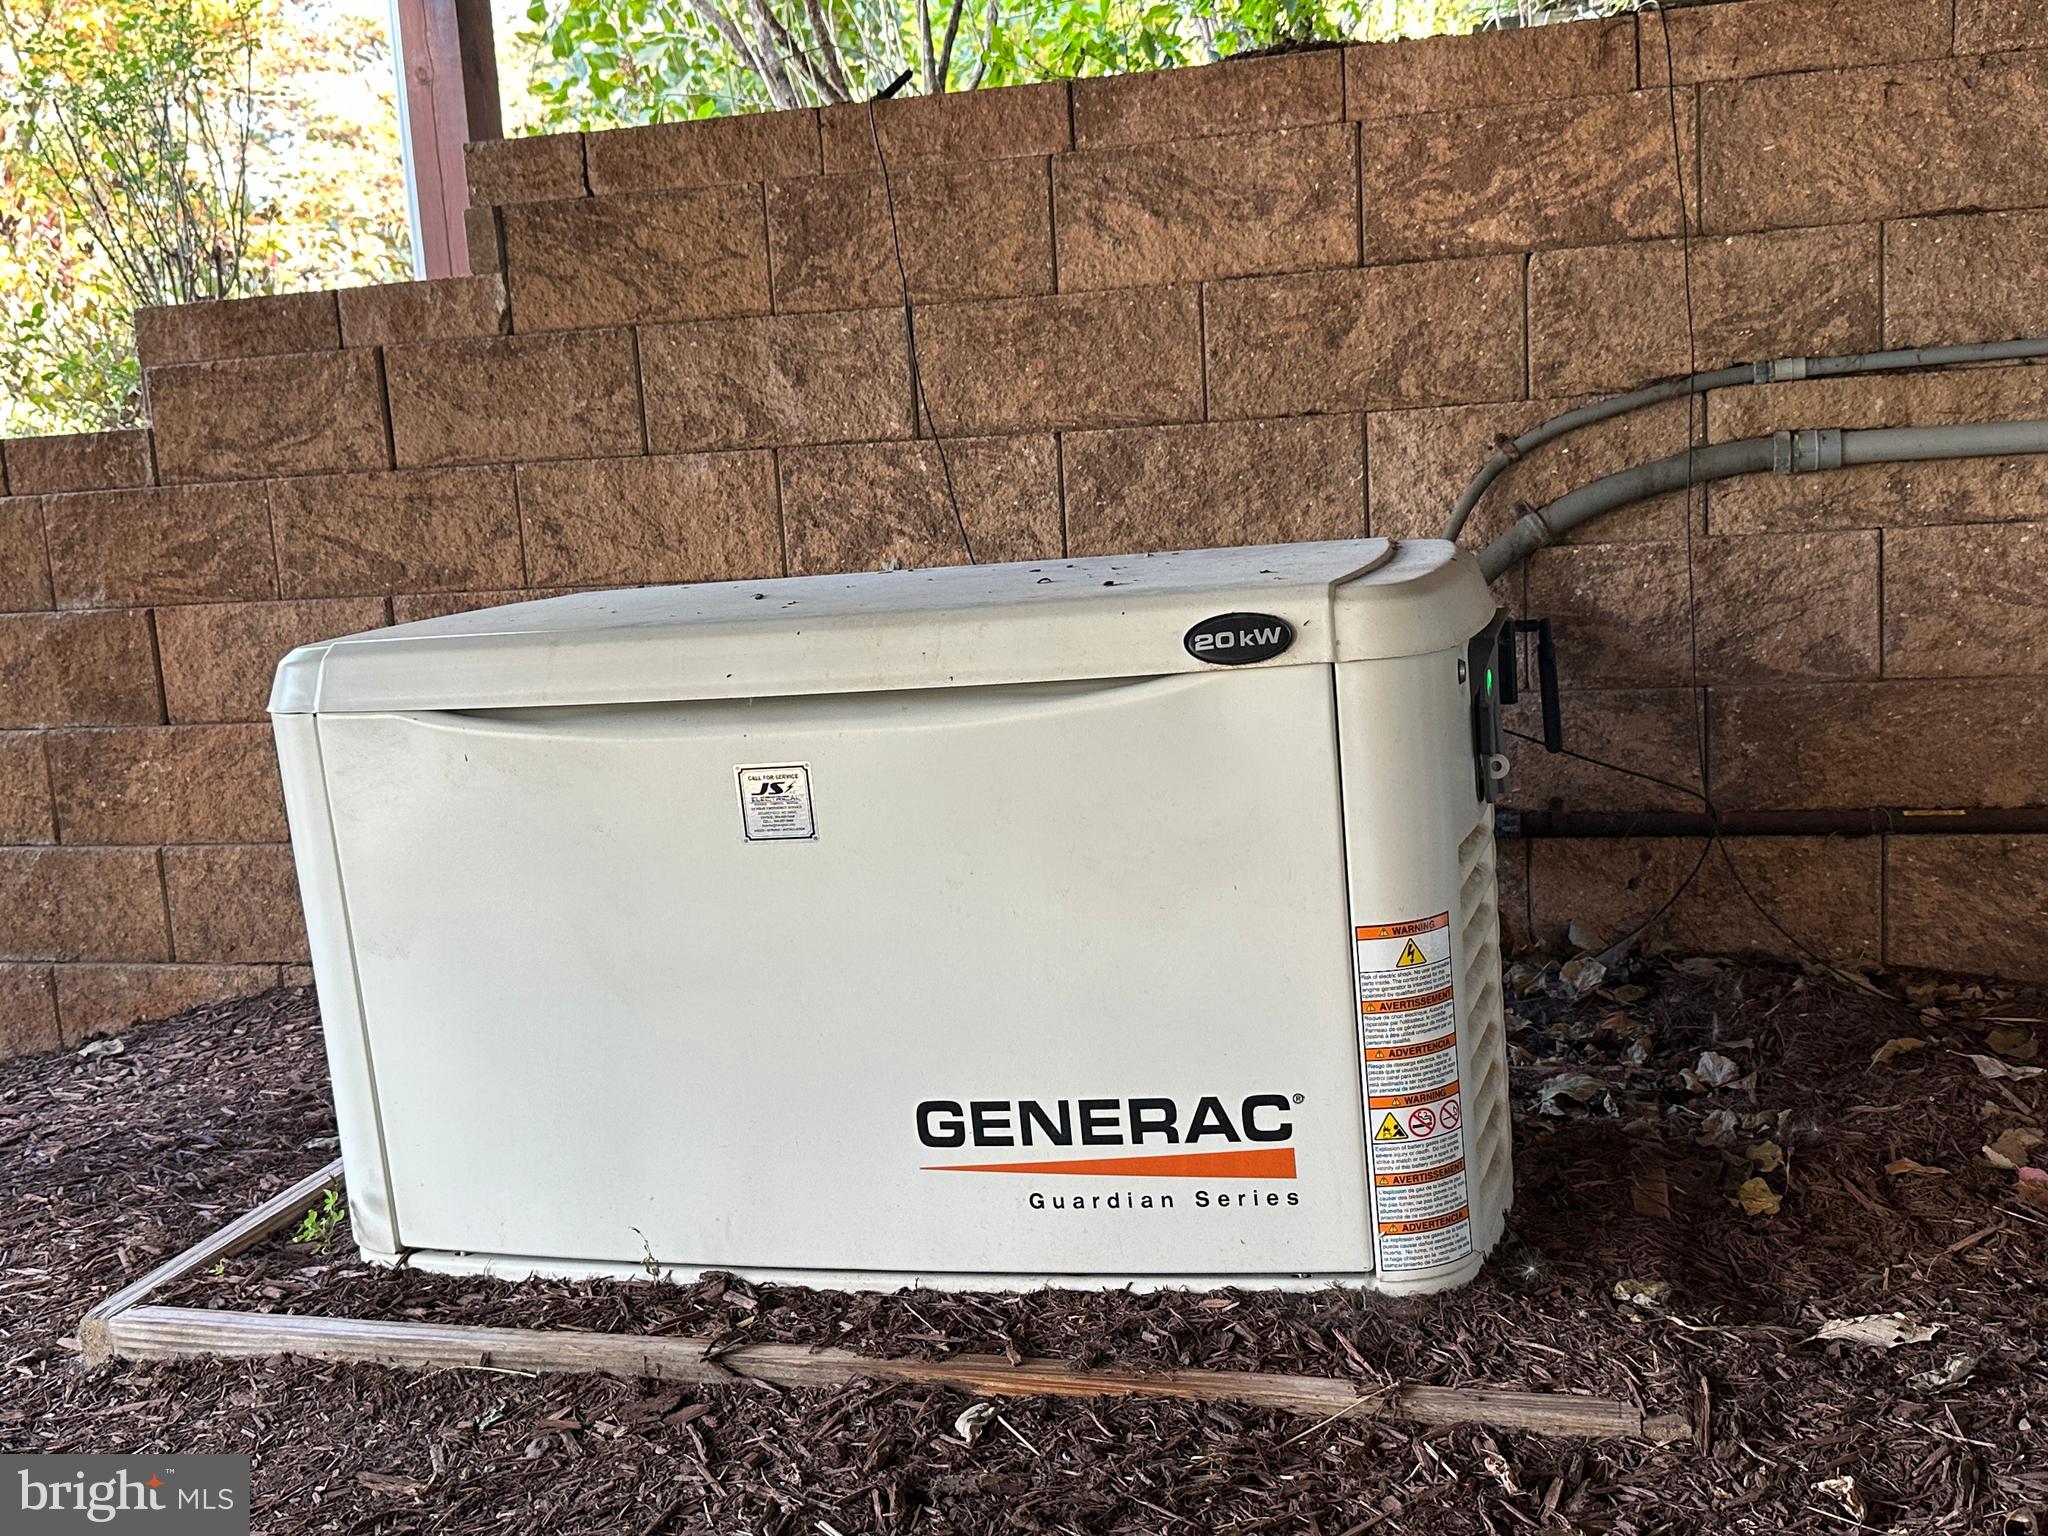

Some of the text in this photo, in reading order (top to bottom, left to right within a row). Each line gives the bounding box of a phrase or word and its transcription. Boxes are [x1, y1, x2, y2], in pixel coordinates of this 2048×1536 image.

[1194, 626, 1282, 652] 20 kW
[751, 782, 785, 795] JS
[1392, 920, 1435, 935] WARNING
[1381, 983, 1406, 992] generator
[1380, 989, 1451, 1011] AVERTISSEMENT
[1389, 1039, 1451, 1058] ADVERTENCIA
[1404, 1089, 1446, 1104] WARNING
[1393, 1163, 1463, 1184] AVERTISSEMENT
[1029, 1189, 1299, 1209] Guardian Series
[1402, 1212, 1463, 1232] ADVERTENCIA
